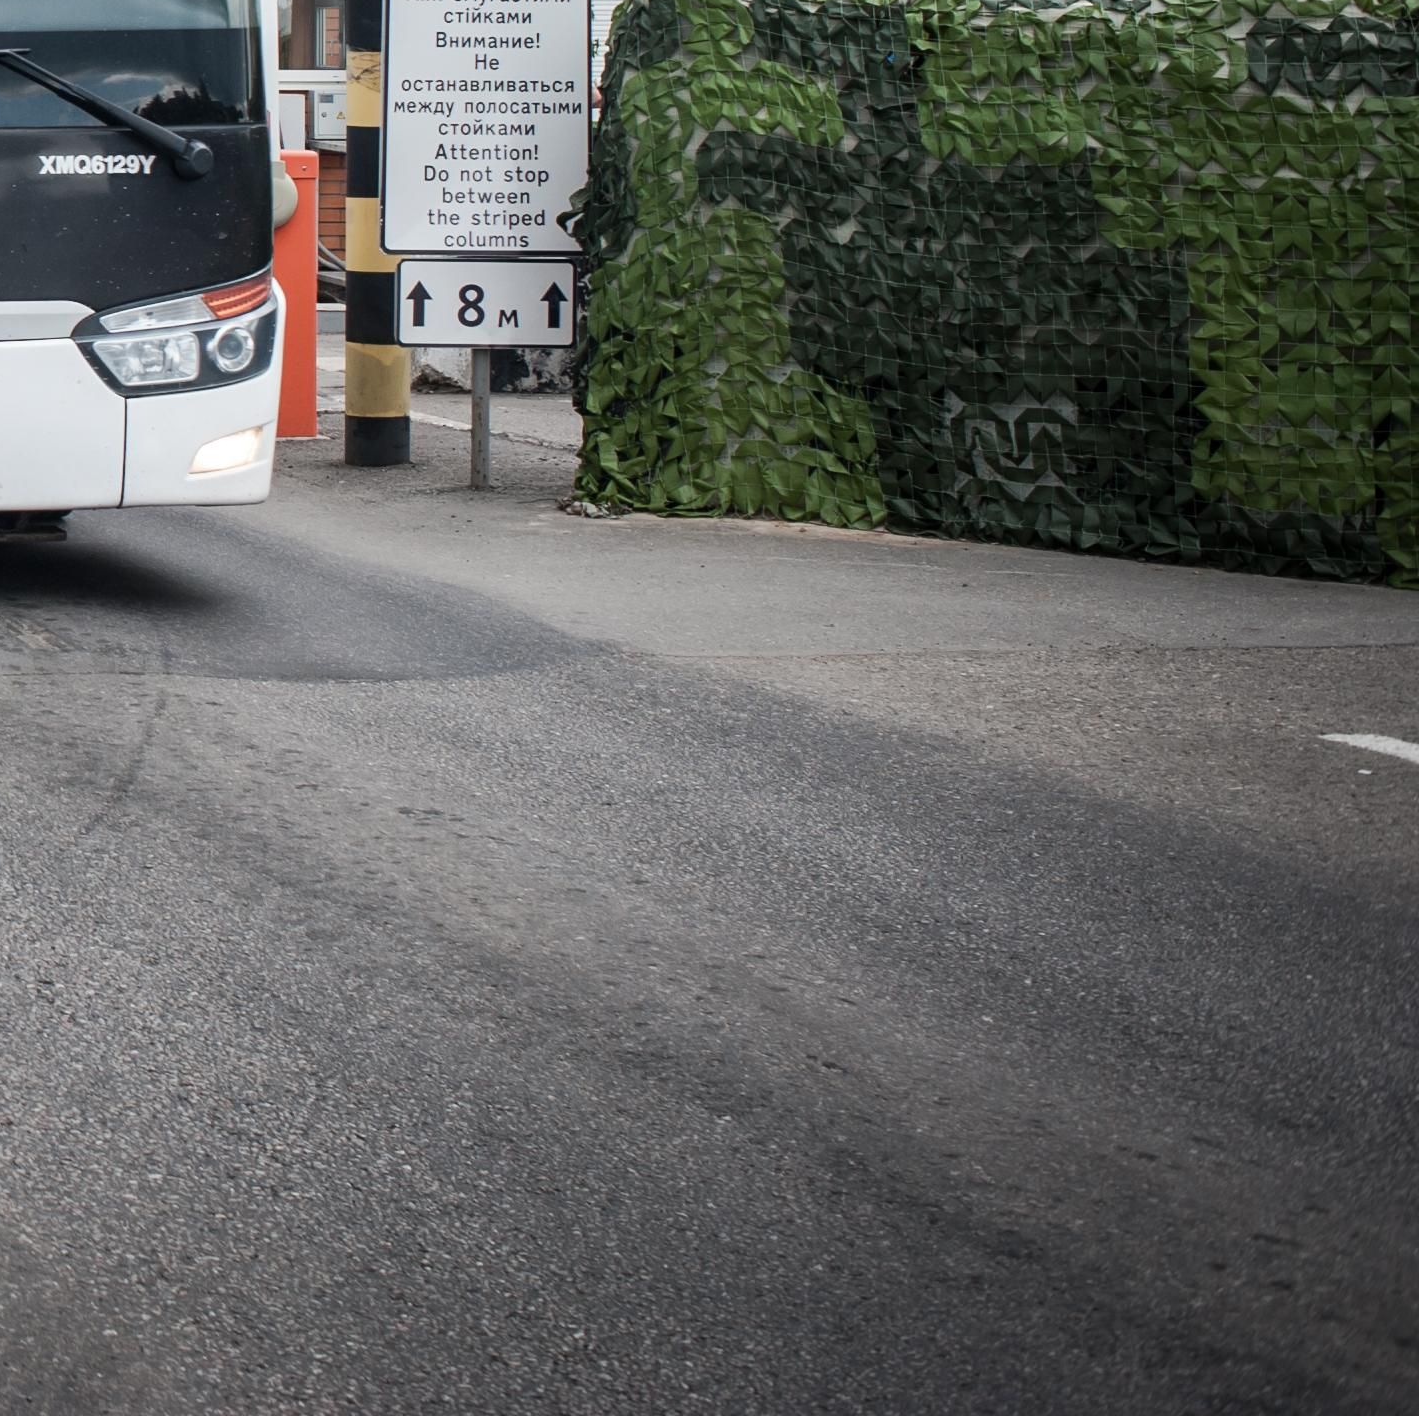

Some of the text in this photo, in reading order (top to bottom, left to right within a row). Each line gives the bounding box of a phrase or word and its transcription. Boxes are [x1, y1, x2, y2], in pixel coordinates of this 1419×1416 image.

[444, 8, 532, 24] стійками
[436, 32, 541, 49] Внимание!
[475, 55, 499, 71] Не
[402, 79, 575, 93] останавливаться
[394, 100, 582, 118] между полосатыми
[438, 120, 535, 136] стойками
[435, 143, 539, 160] Attention!
[39, 155, 156, 176] XMQ6129Y
[424, 166, 549, 186] Do not stop
[442, 187, 530, 204] between
[427, 209, 546, 230] the striped
[444, 231, 529, 248] columns
[458, 284, 485, 327] 8
